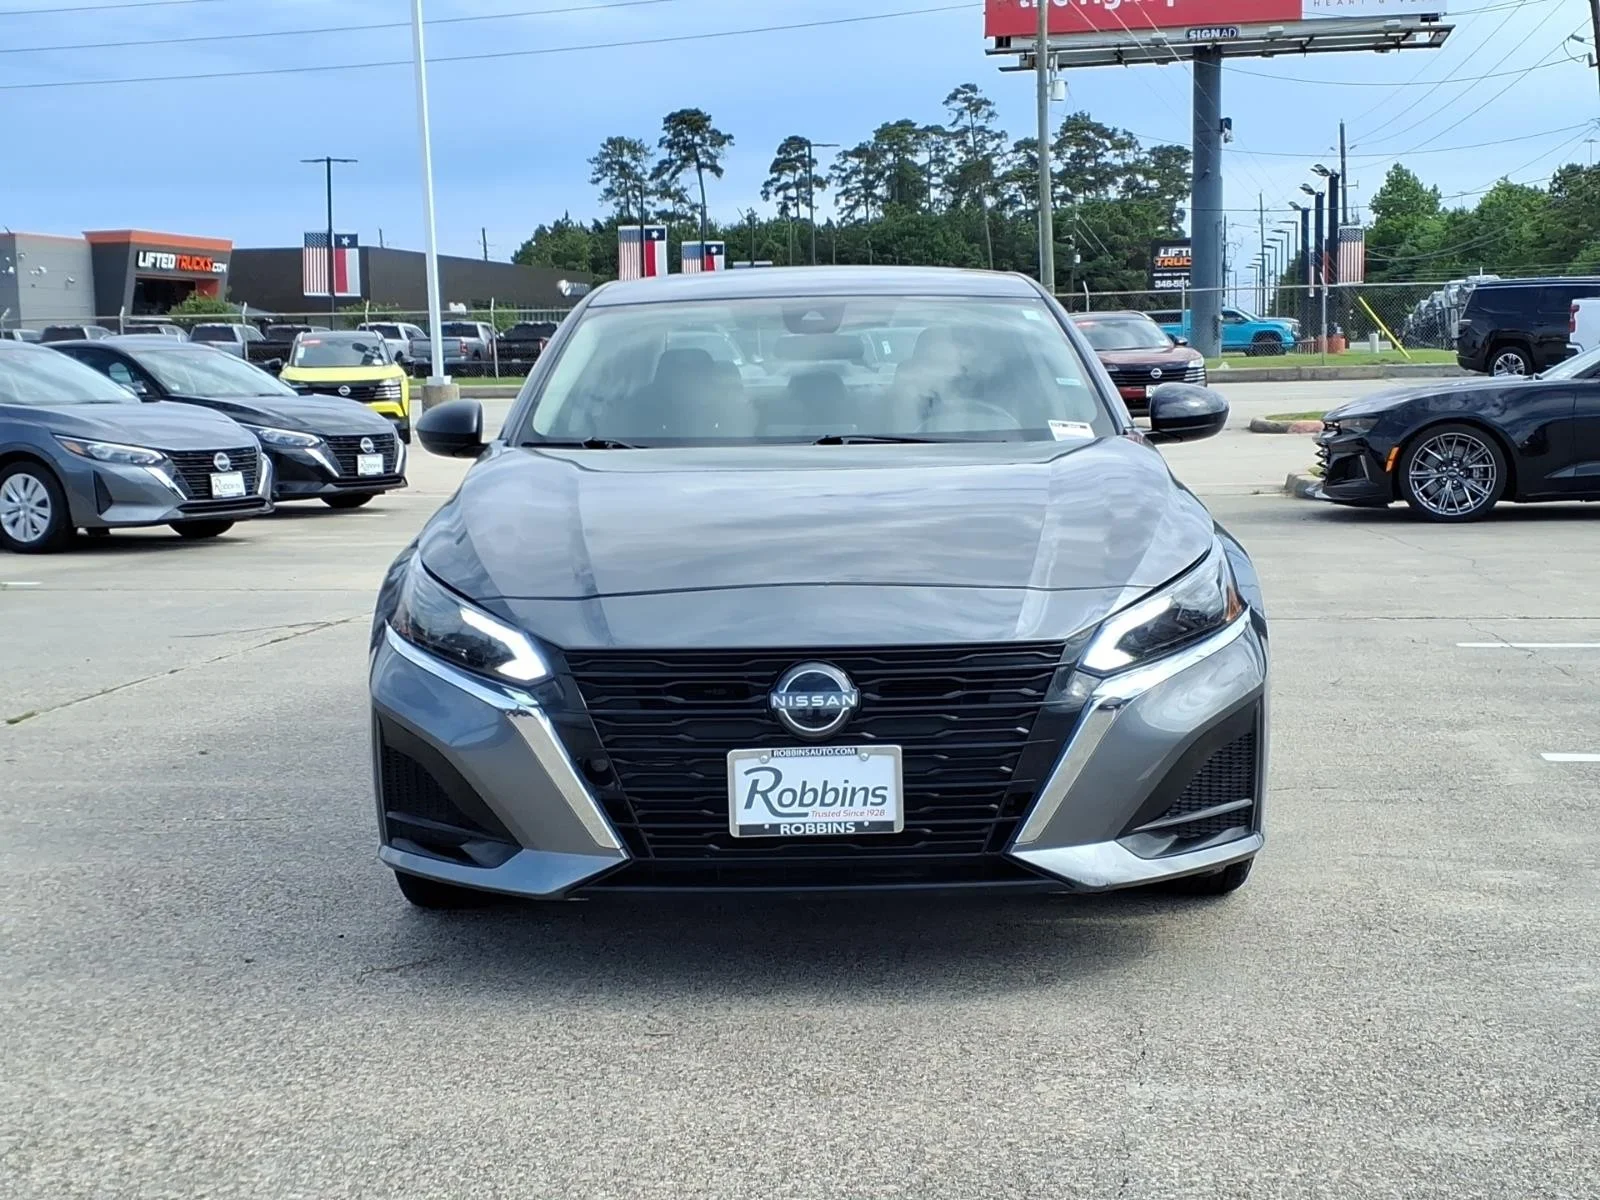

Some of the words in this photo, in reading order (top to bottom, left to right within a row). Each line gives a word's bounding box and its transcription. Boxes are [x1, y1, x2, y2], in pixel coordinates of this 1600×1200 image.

[1189, 27, 1237, 40] SIGNAD
[1159, 247, 1191, 257] LIFT
[772, 694, 856, 708] NISSAN
[773, 747, 855, 758] ROBBINSAUTO.COM
[743, 766, 888, 818] Robbins
[811, 810, 841, 818] Trusted
[843, 809, 865, 818] Since
[866, 809, 886, 817] 1928
[780, 822, 856, 836] ROBBINS
